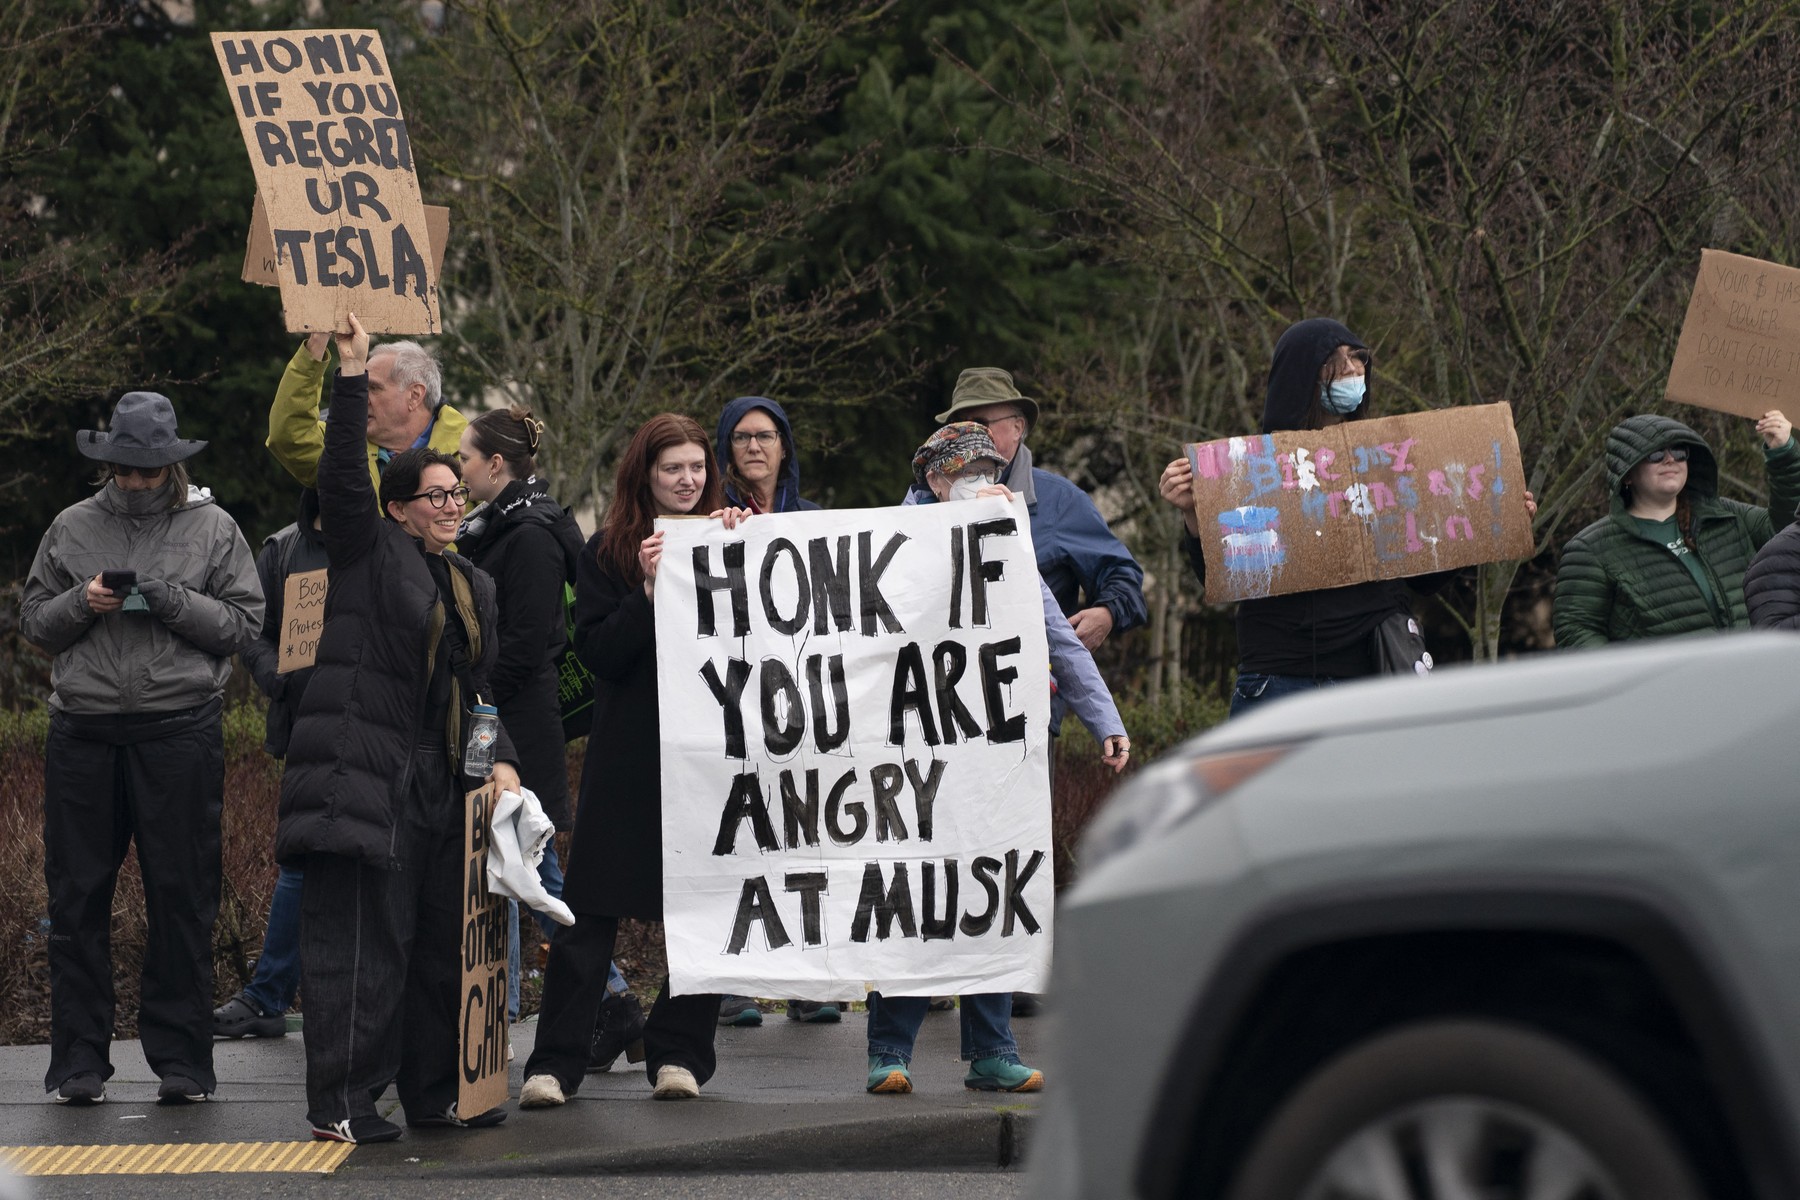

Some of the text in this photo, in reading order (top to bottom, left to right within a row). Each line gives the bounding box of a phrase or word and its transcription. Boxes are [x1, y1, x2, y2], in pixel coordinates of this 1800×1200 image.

[222, 34, 384, 75] HONK
[238, 81, 399, 117] IF YOU
[255, 117, 413, 171] REGRET
[305, 171, 392, 222] UR
[274, 223, 428, 296] TESLA
[1716, 265, 1749, 294] YOUR
[1703, 365, 1782, 398] TO A NAZI
[1746, 343, 1783, 368] GIVE
[692, 517, 1018, 639] HONK IF
[699, 635, 1028, 763] YOU ARE
[712, 758, 948, 856] ANGRY
[720, 849, 1046, 956] AT MUSK
[465, 896, 509, 973] OTHER
[463, 966, 507, 1084] CAR
